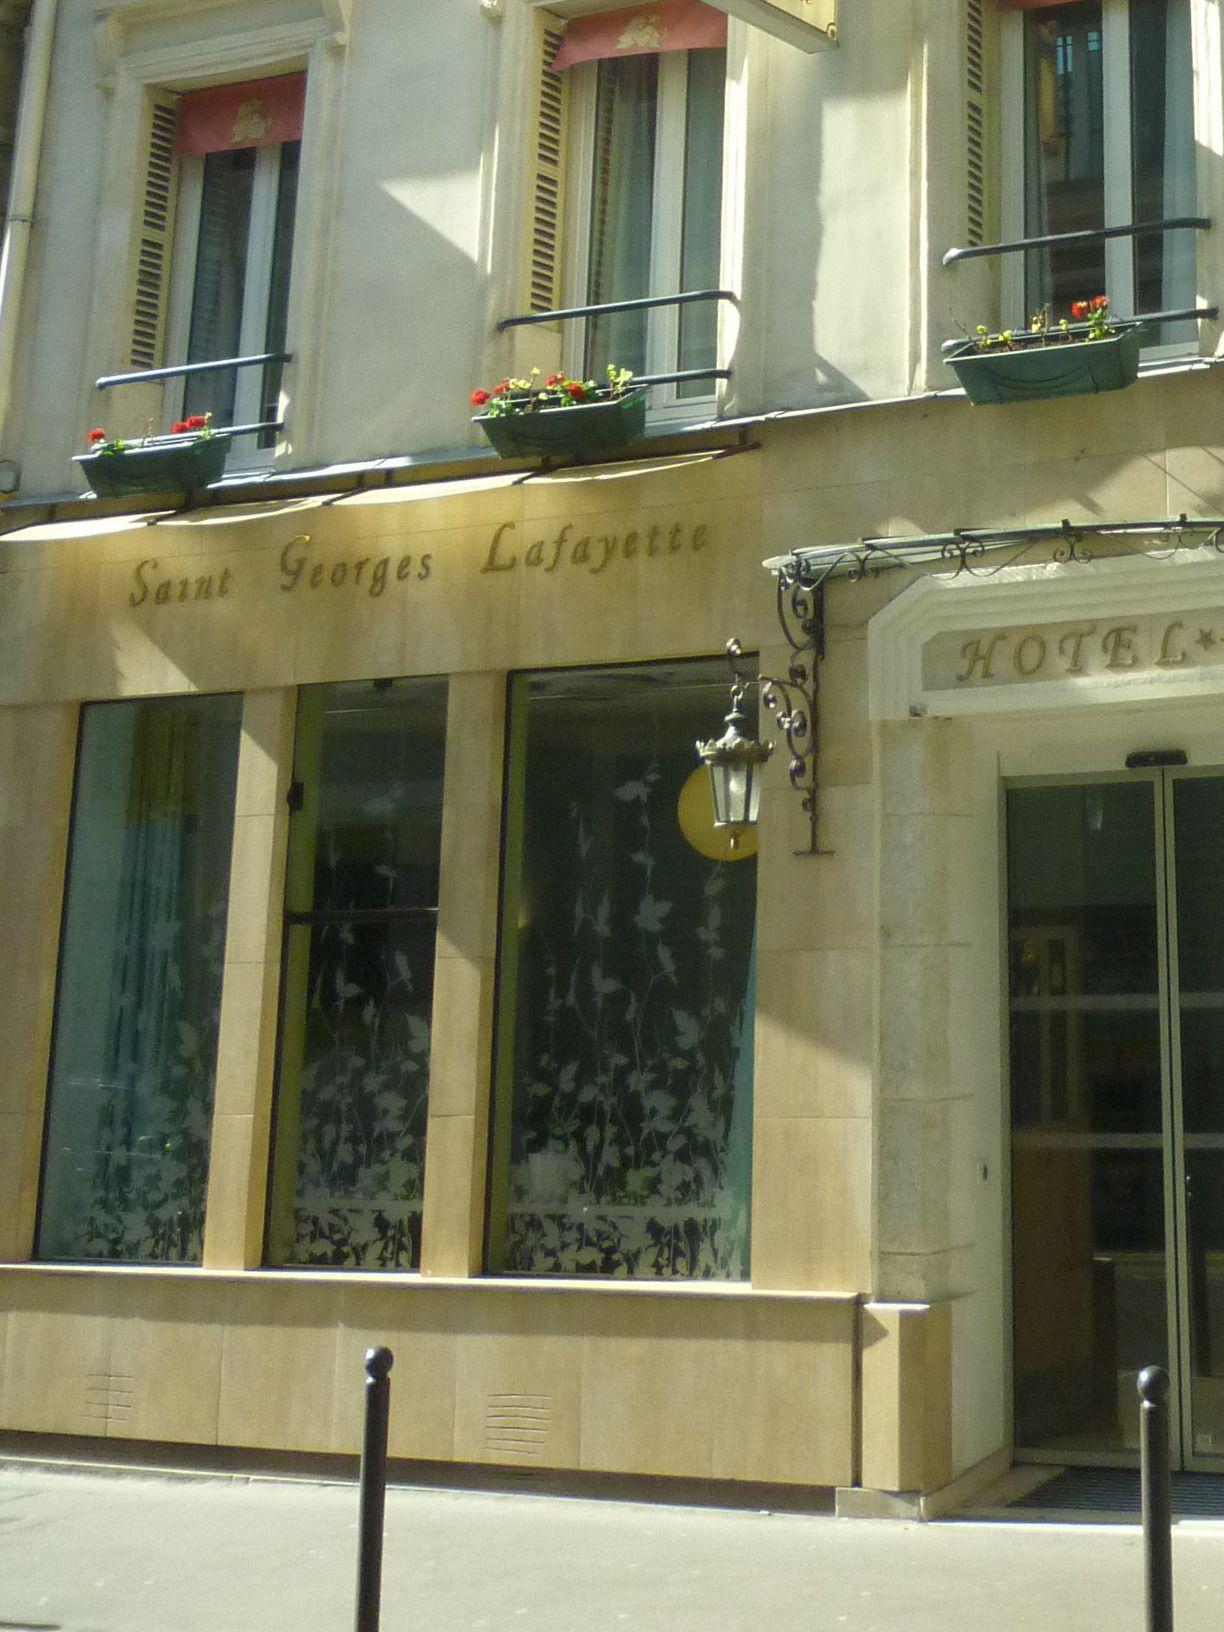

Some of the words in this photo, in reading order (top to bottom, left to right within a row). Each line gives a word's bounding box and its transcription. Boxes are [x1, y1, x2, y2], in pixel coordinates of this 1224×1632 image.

[128, 558, 233, 608] Saint
[279, 534, 434, 599] Georges
[481, 521, 709, 574] Lafayette
[956, 620, 1186, 682] HOTEL
